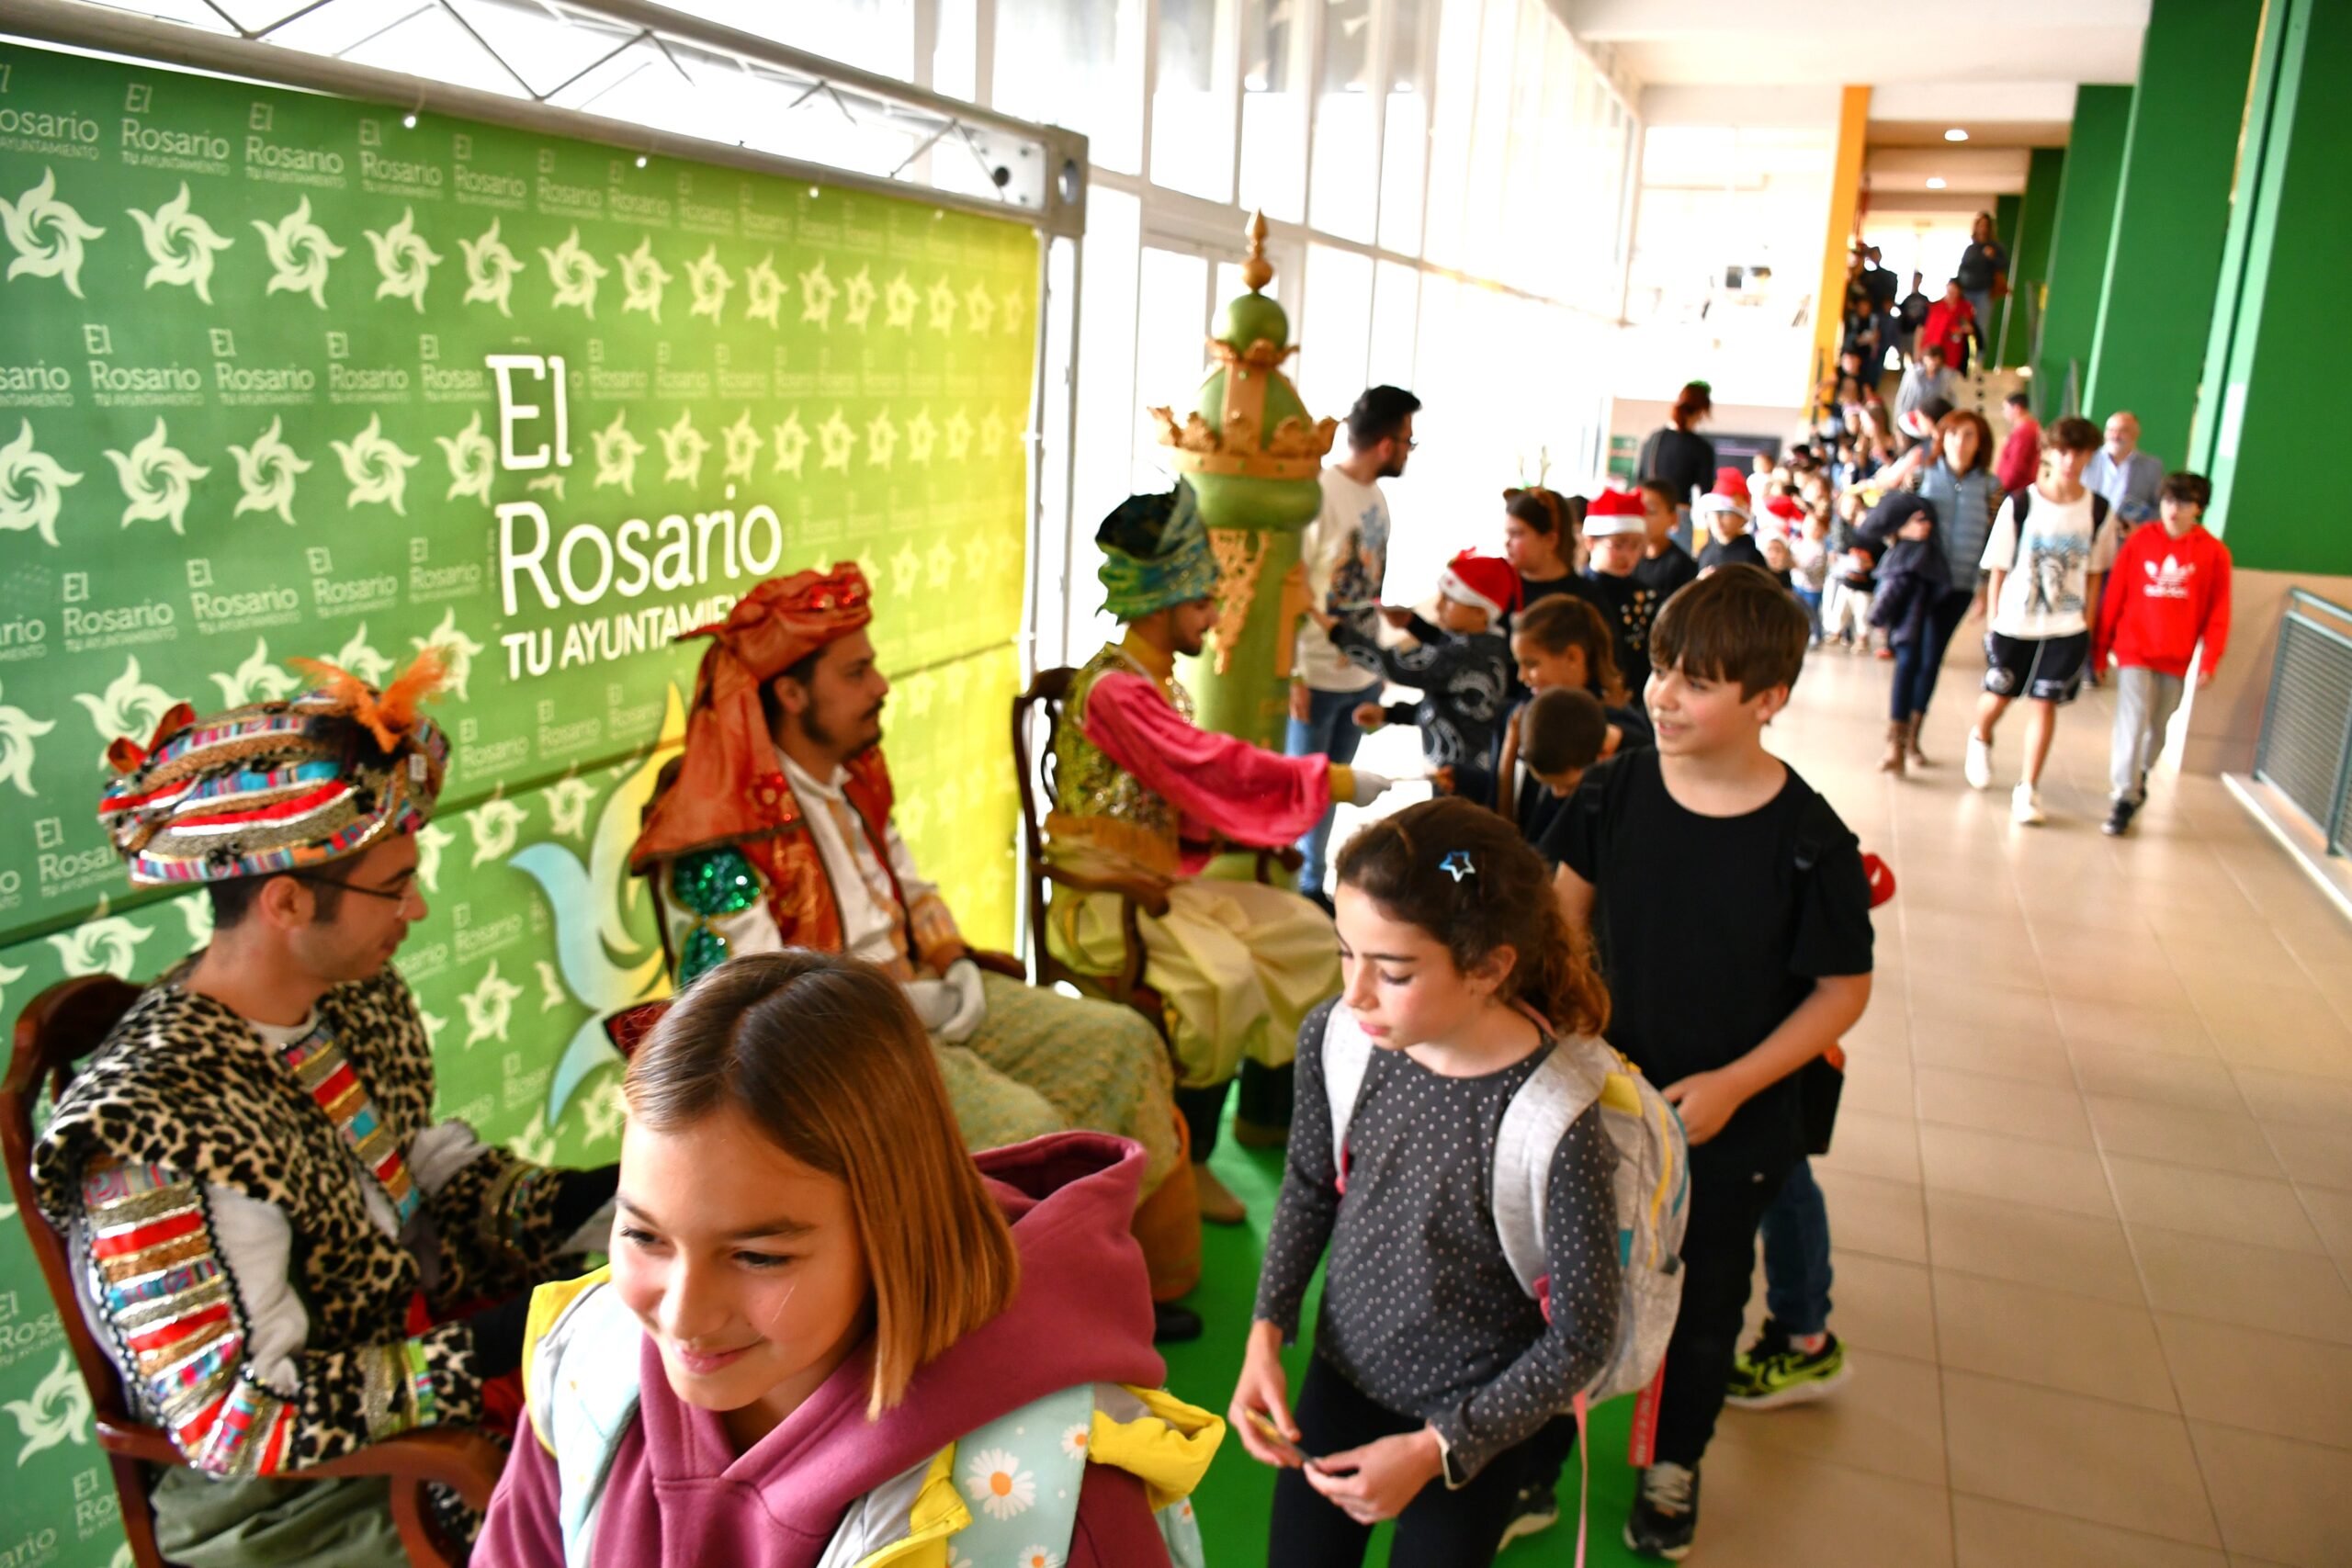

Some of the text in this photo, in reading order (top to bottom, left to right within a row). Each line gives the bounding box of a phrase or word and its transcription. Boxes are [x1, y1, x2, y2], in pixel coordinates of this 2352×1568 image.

[125, 84, 153, 114] El
[0, 109, 99, 143] osario
[249, 103, 273, 131] El
[358, 119, 381, 146] El
[121, 118, 230, 160] Rosario
[246, 136, 345, 175] Rosario
[359, 151, 443, 186] Rosario
[454, 164, 527, 198] Rosario
[83, 324, 113, 355] El
[208, 328, 237, 357] El
[325, 332, 349, 359] El
[87, 359, 202, 390] Rosario
[214, 361, 316, 391] Rosario
[328, 363, 410, 390] Rosario
[485, 355, 572, 470] El
[306, 547, 334, 576] El
[494, 483, 783, 616] Rosario
[62, 571, 89, 602] El
[186, 558, 213, 589] El
[311, 571, 399, 605] Rosario
[410, 562, 481, 591] Rosario
[62, 597, 175, 637] Rosario
[190, 583, 300, 620] Rosario
[501, 592, 748, 681] TU AYUNTAMIE
[34, 816, 64, 850] El
[72, 1467, 99, 1501] El
